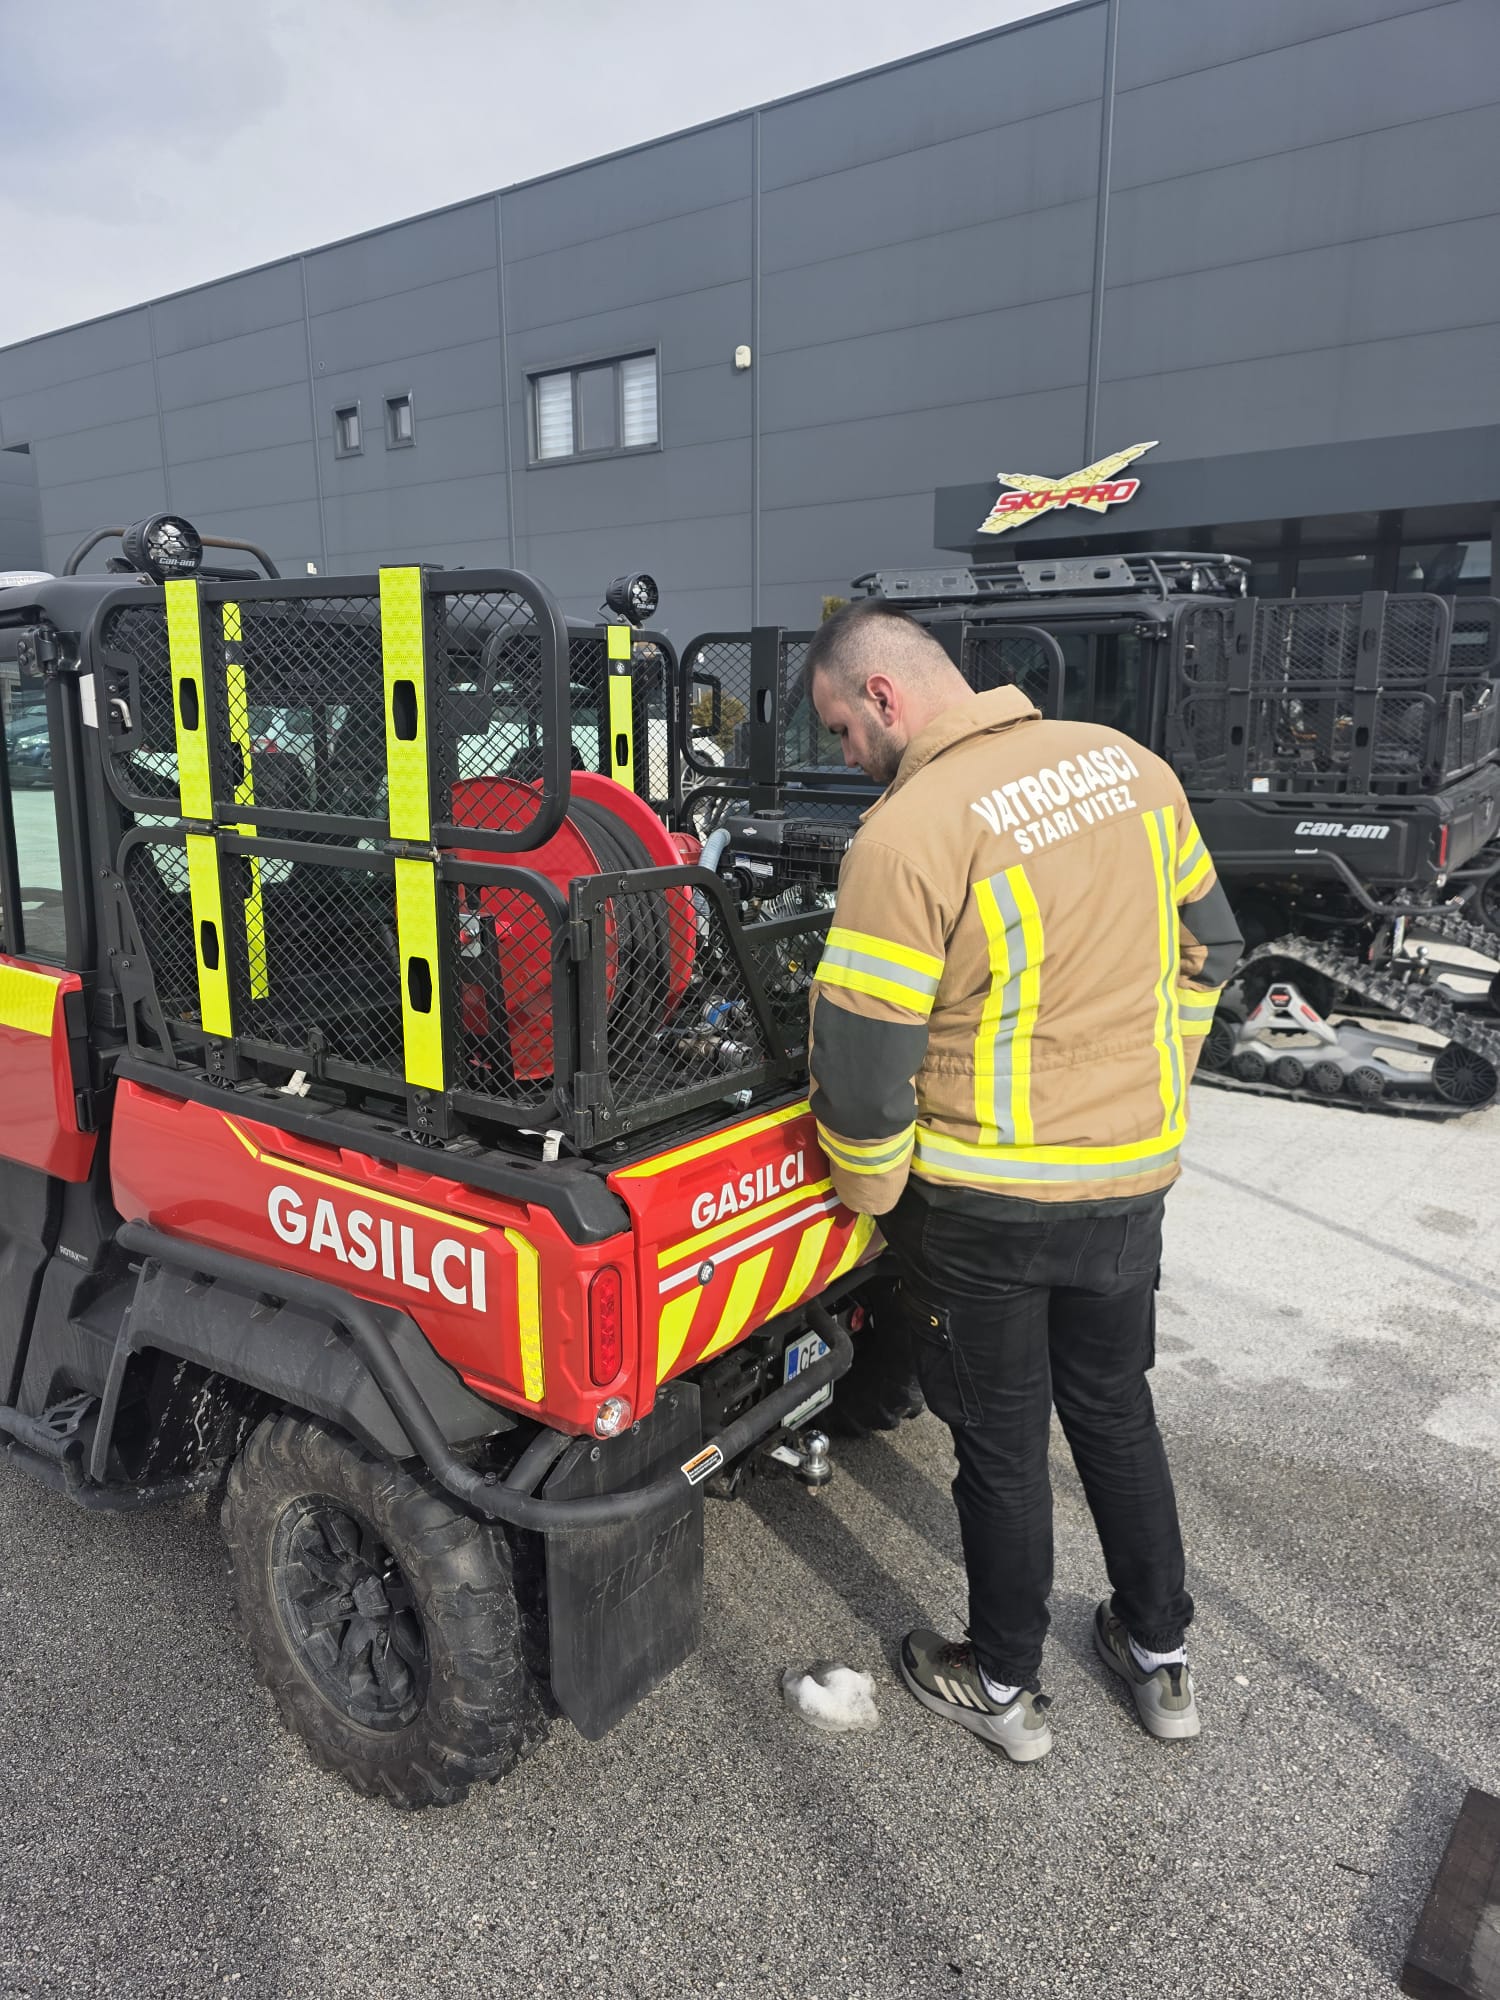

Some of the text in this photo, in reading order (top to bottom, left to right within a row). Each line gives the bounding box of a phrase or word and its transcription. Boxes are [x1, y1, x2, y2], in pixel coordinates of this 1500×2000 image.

[993, 481, 1138, 513] SKI-PRO
[159, 557, 195, 567] can-am
[970, 745, 1140, 835] VATROGASCI
[1013, 785, 1137, 854] STARI VITEZ
[1294, 821, 1390, 839] can-am
[690, 1150, 804, 1230] GASILCI
[268, 1185, 487, 1312] GASILCI
